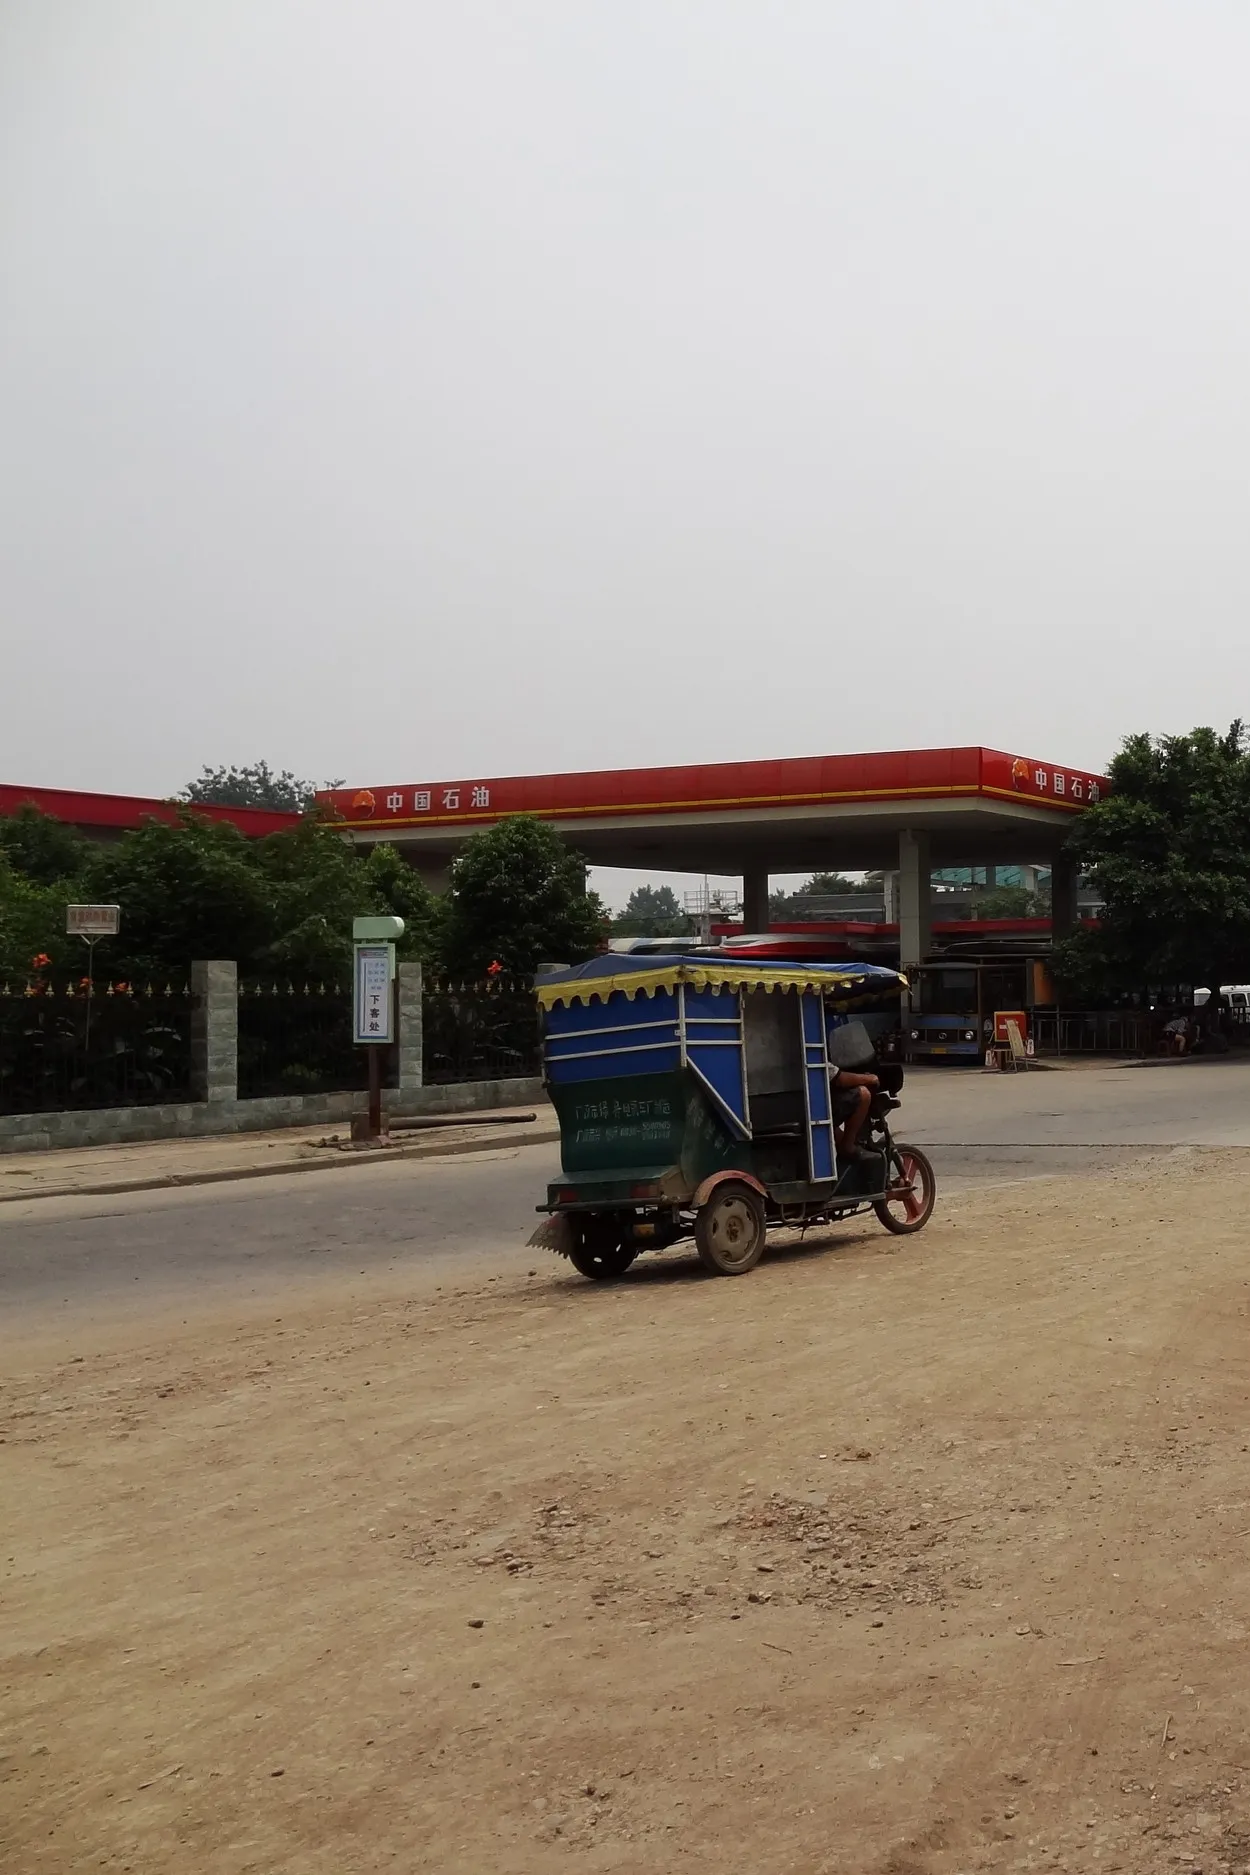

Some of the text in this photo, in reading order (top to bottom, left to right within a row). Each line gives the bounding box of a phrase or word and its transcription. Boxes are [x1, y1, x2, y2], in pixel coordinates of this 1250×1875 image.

[387, 786, 490, 812] 中国石油
[1035, 768, 1100, 802] 中国石油
[369, 994, 380, 1032] 下客处
